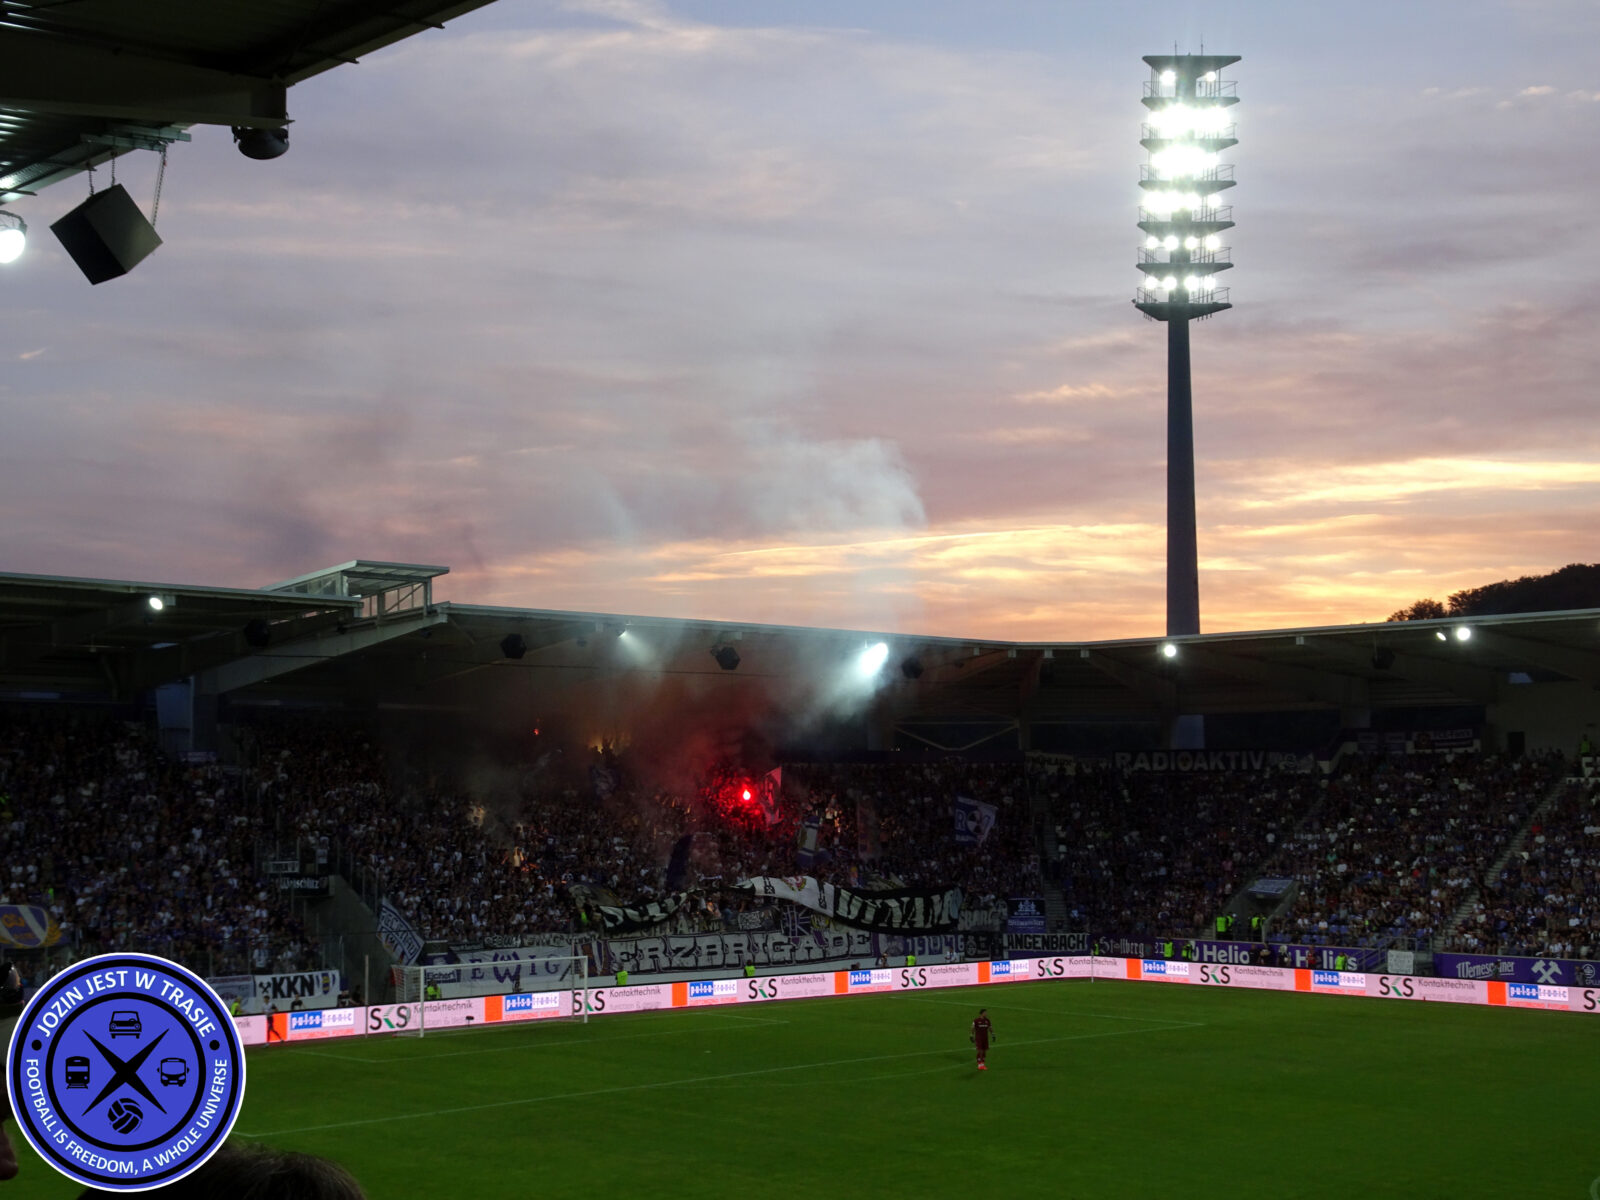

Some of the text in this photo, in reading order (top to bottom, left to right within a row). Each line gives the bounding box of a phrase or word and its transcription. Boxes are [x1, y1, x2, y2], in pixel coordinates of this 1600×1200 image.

[1114, 751, 1264, 772] RADIOAKTIV
[606, 931, 873, 974] ERZBRIGADE
[1068, 957, 1118, 967] Kontakttechnik
[930, 965, 970, 975] Kontakttechnik
[1234, 966, 1284, 977] Kontakttechnik
[780, 975, 826, 985] Kontakttechnik
[1418, 979, 1475, 990] Kontakttechnik
[272, 975, 314, 998] KKN
[609, 986, 662, 998] Kontakttechnik
[413, 1001, 473, 1013] Kntakttechnik
